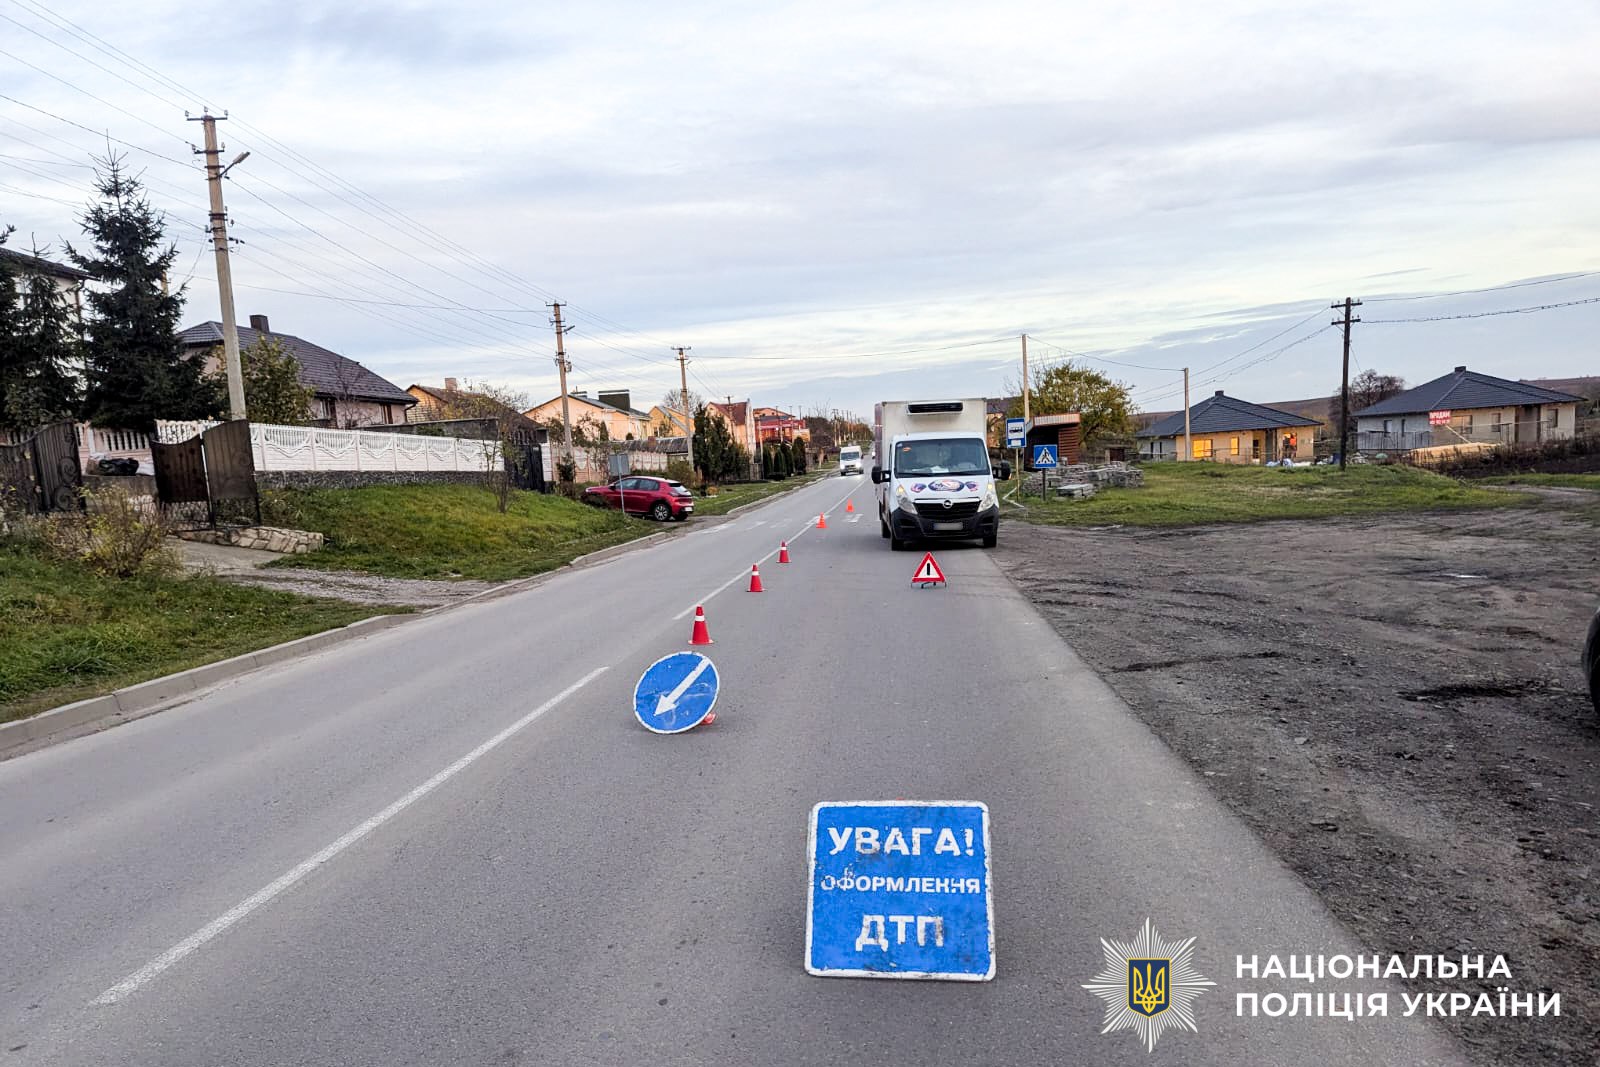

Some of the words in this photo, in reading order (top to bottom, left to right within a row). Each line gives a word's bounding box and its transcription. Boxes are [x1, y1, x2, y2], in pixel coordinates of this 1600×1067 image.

[827, 827, 974, 856] УВАГА!
[821, 865, 980, 893] ОФОРМЛЕННЯ
[855, 914, 943, 952] ДТП
